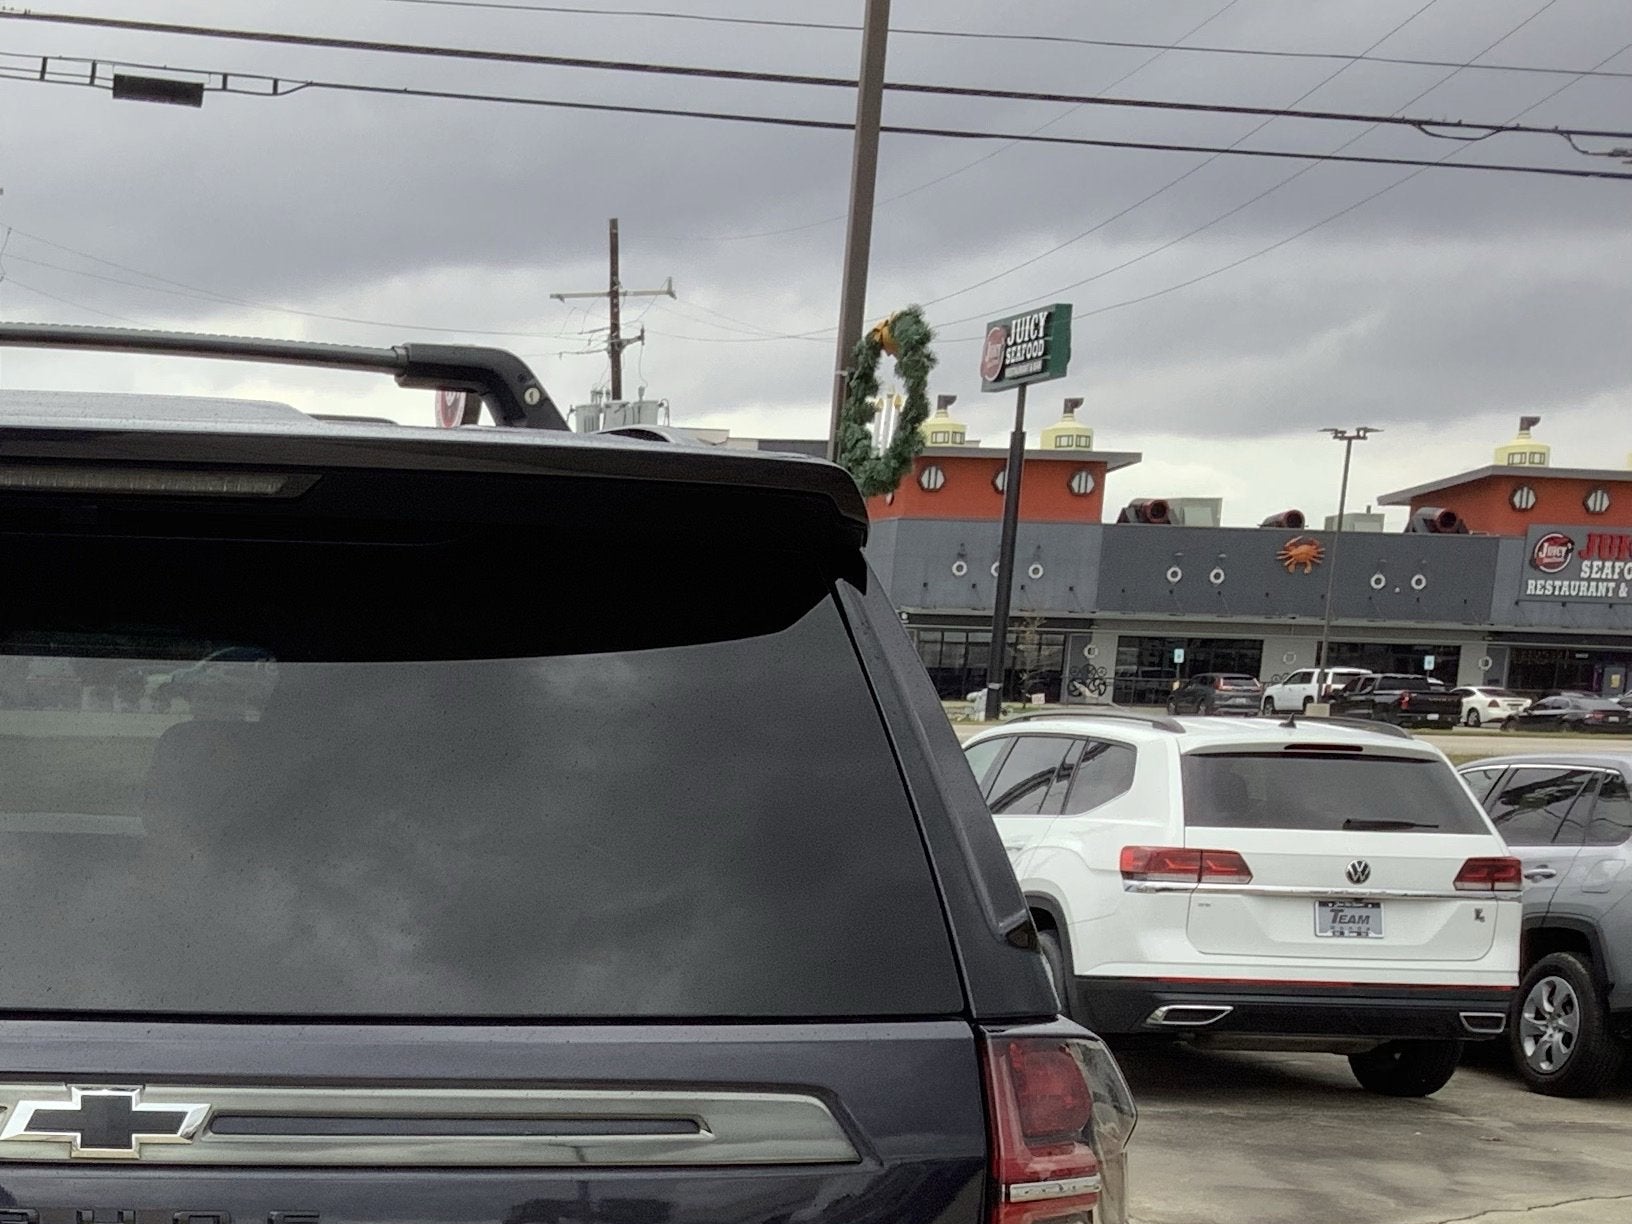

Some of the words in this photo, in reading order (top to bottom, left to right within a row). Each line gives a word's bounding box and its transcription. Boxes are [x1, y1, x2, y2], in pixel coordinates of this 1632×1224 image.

[1007, 311, 1047, 346] JUICY
[1005, 339, 1044, 365] SEAFOOD
[1526, 579, 1616, 597] RESTAURANT
[1618, 582, 1628, 597] &
